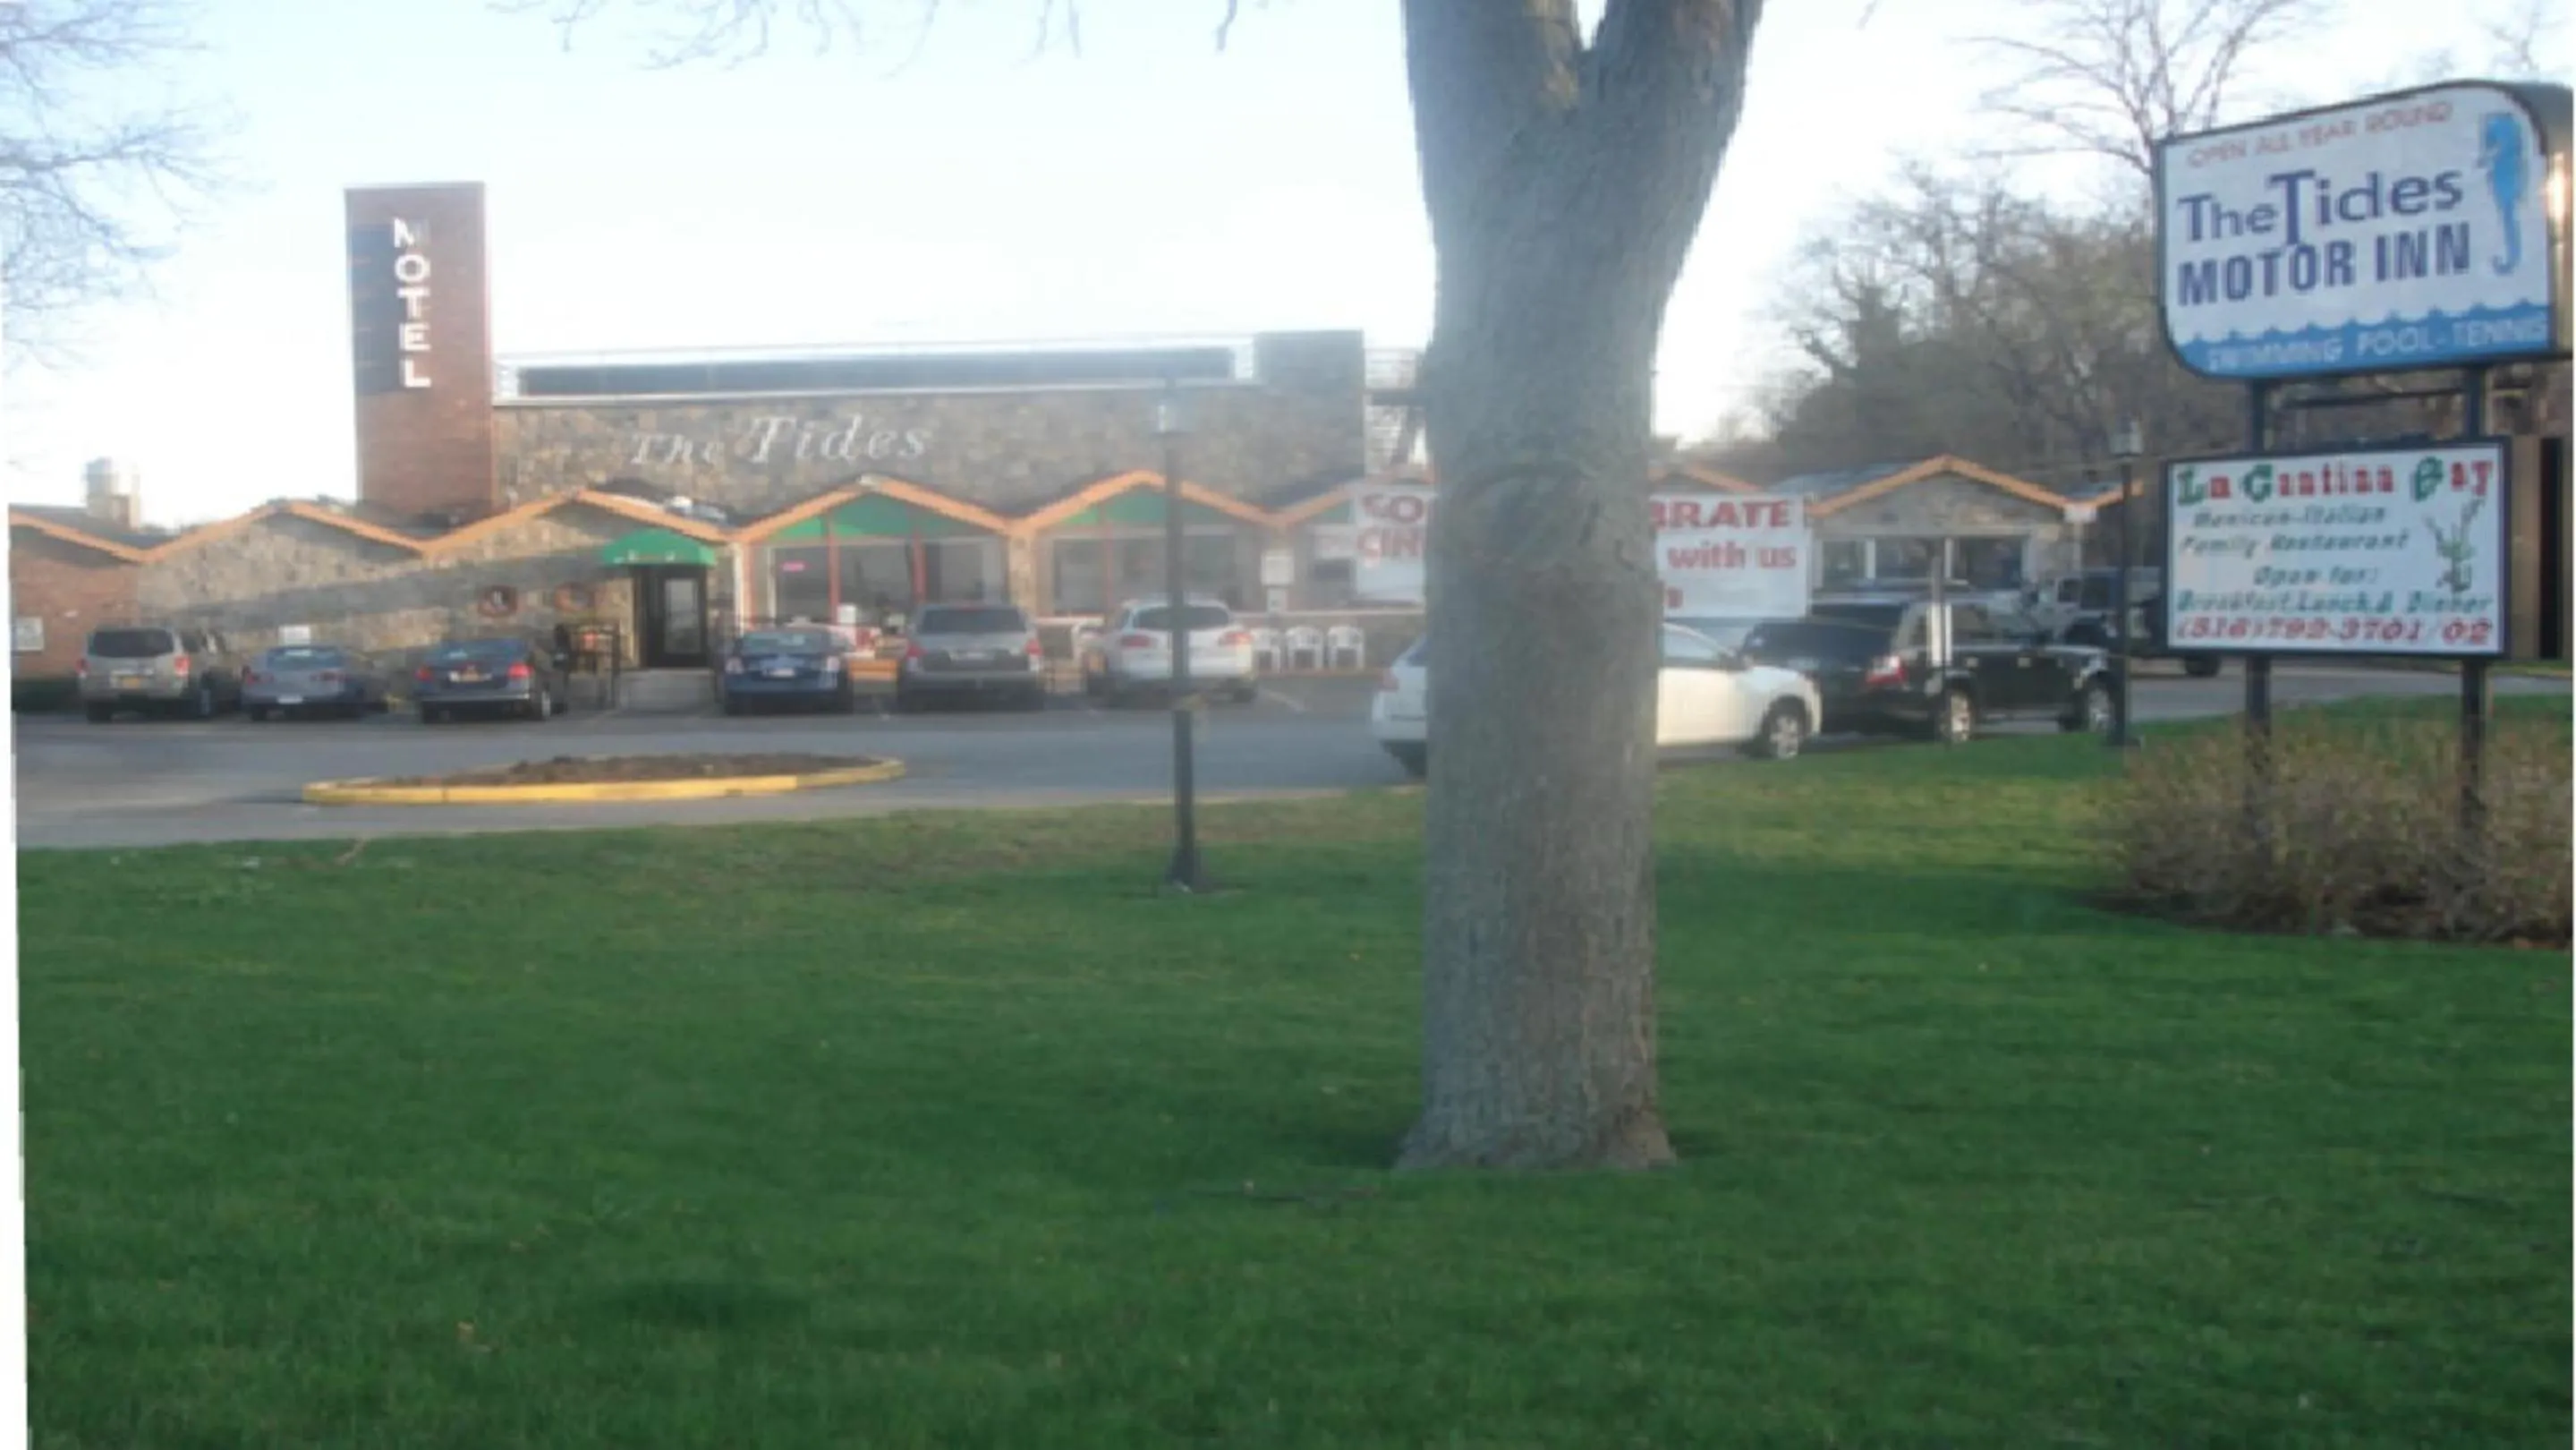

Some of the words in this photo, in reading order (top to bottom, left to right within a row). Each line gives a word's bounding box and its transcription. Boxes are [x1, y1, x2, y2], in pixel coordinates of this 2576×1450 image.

[2298, 120, 2358, 149] YEAR
[2367, 103, 2452, 132] ROUND
[2177, 238, 2355, 306] MOTOR
[2376, 222, 2470, 282] INN
[394, 217, 431, 388] MOTEL
[751, 414, 927, 462] Tides
[2177, 467, 2232, 507] La
[1356, 525, 1424, 559] CIN
[1667, 541, 1746, 569] with
[1758, 547, 1797, 569] us
[2269, 528, 2410, 552] Restaurant
